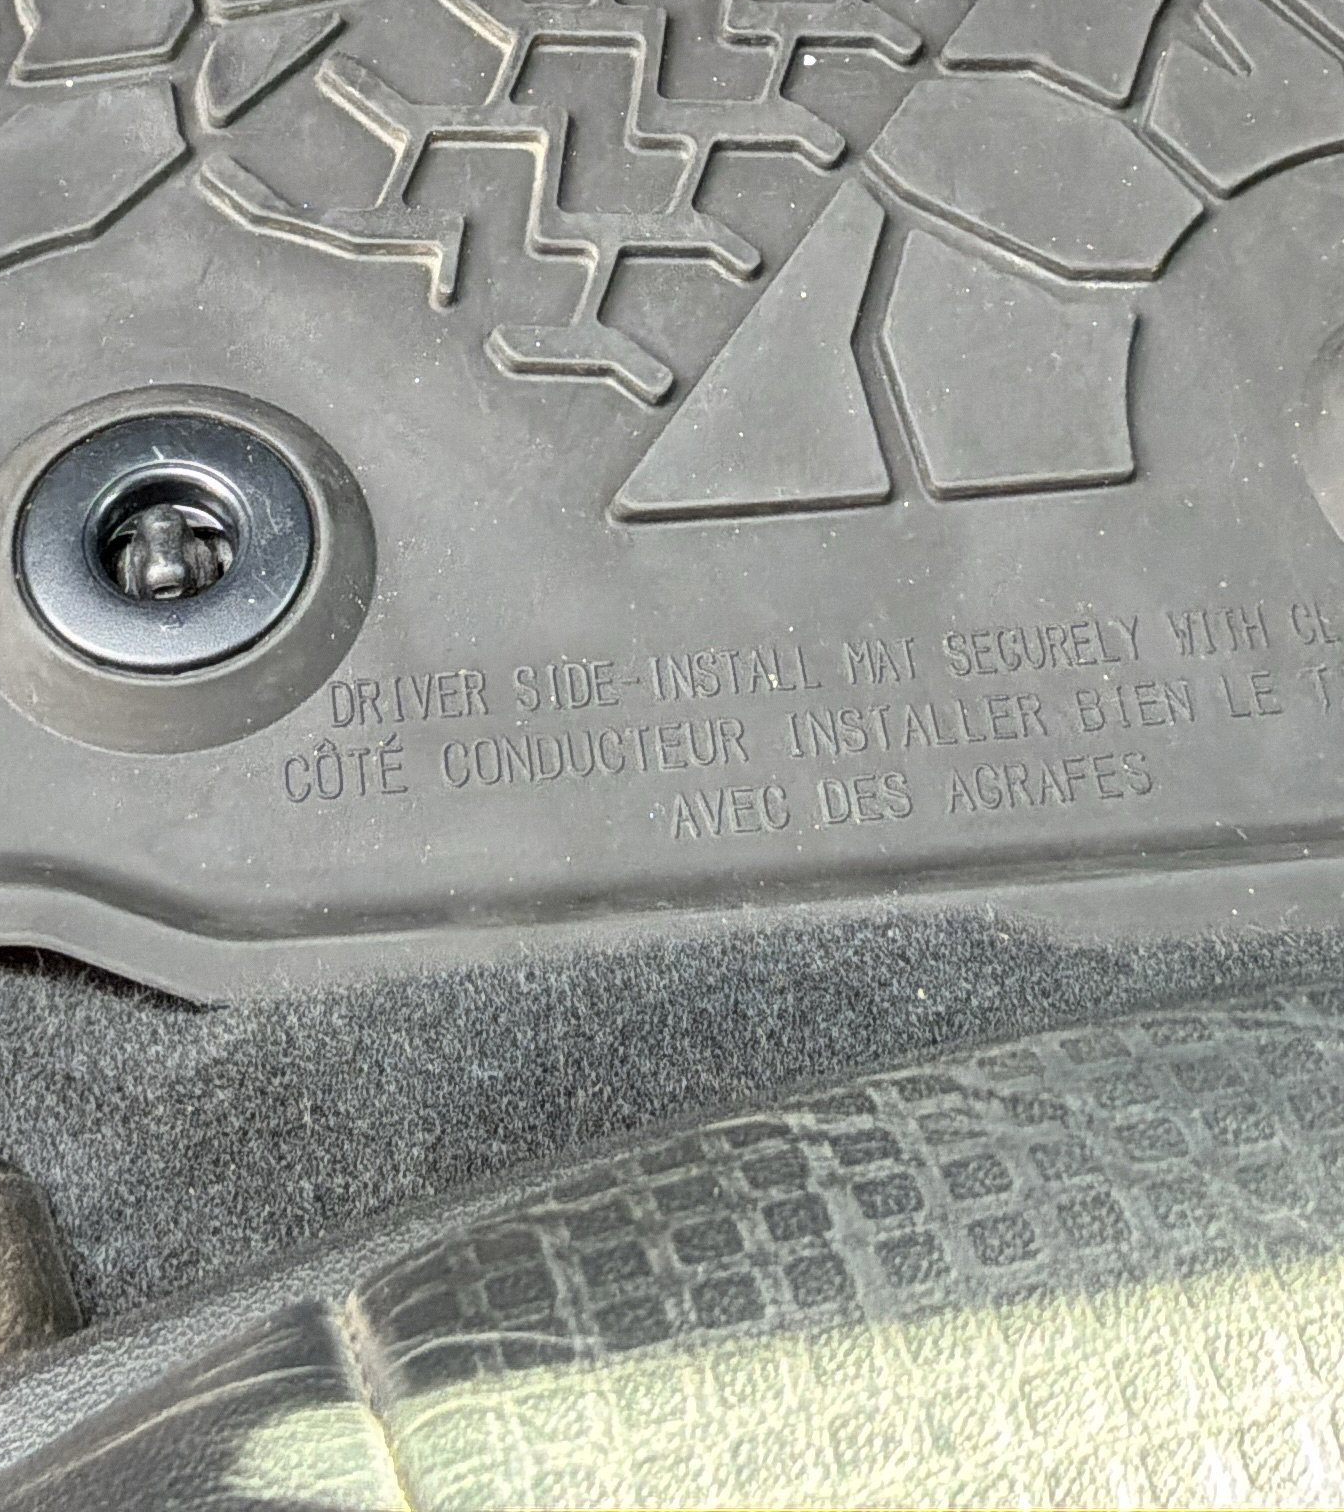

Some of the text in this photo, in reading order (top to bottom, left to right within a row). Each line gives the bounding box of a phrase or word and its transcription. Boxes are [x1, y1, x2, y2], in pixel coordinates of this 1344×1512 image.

[329, 670, 490, 729] DRIVER
[844, 637, 916, 686] MAT
[944, 614, 1141, 677] SECURELY
[1167, 604, 1271, 658] WITH
[283, 734, 408, 803] CÔTÉ
[441, 717, 749, 789] CONDUCTEUR
[789, 691, 1049, 759] INSTALLER
[1076, 675, 1196, 734] BIEN
[1223, 669, 1283, 719] LE
[670, 750, 1155, 841] AVEC DES AGRAFES
